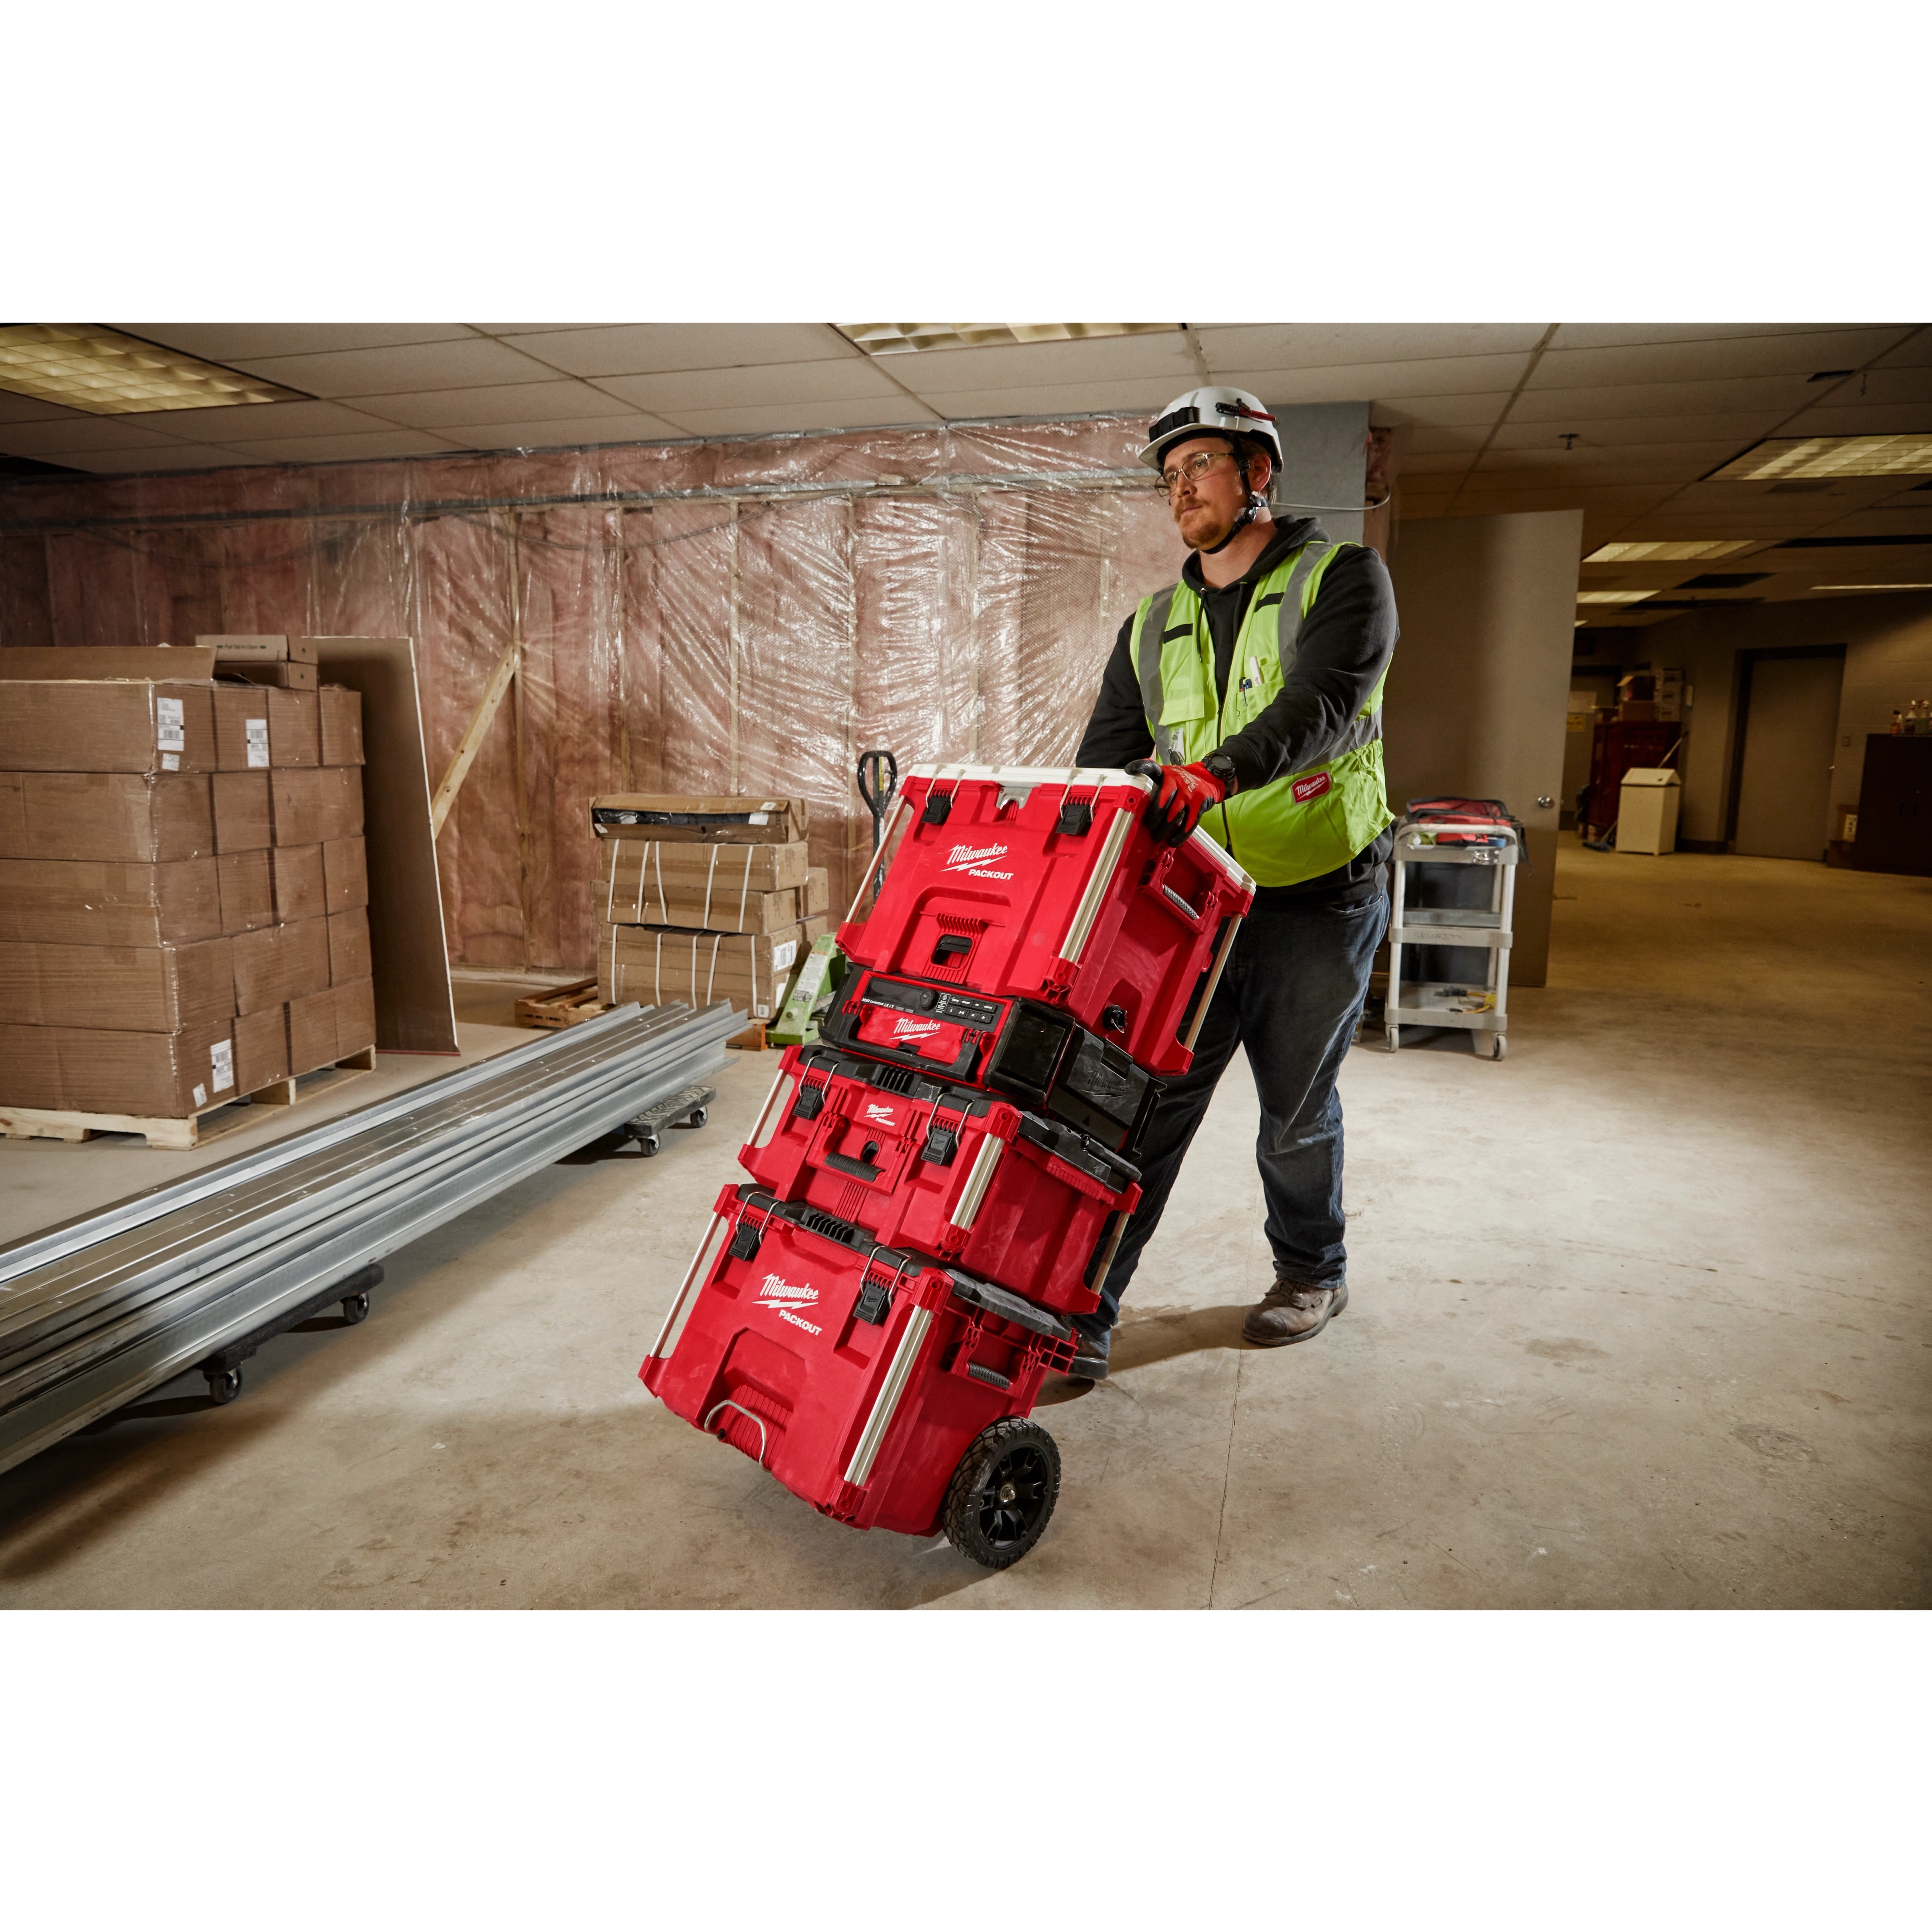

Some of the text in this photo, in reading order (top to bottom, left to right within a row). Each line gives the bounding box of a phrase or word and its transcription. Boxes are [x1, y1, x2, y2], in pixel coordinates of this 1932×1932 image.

[1294, 776, 1326, 796] Milwaukee
[947, 843, 1008, 866] Milwaukee
[967, 868, 1014, 881] PACKOUT
[893, 1017, 941, 1035] Milwaukee
[866, 1103, 894, 1114] Milwaukee
[875, 1117, 895, 1127] PACKOUT
[759, 1273, 819, 1300] Milwaukee
[778, 1309, 823, 1336] PACKOUT
